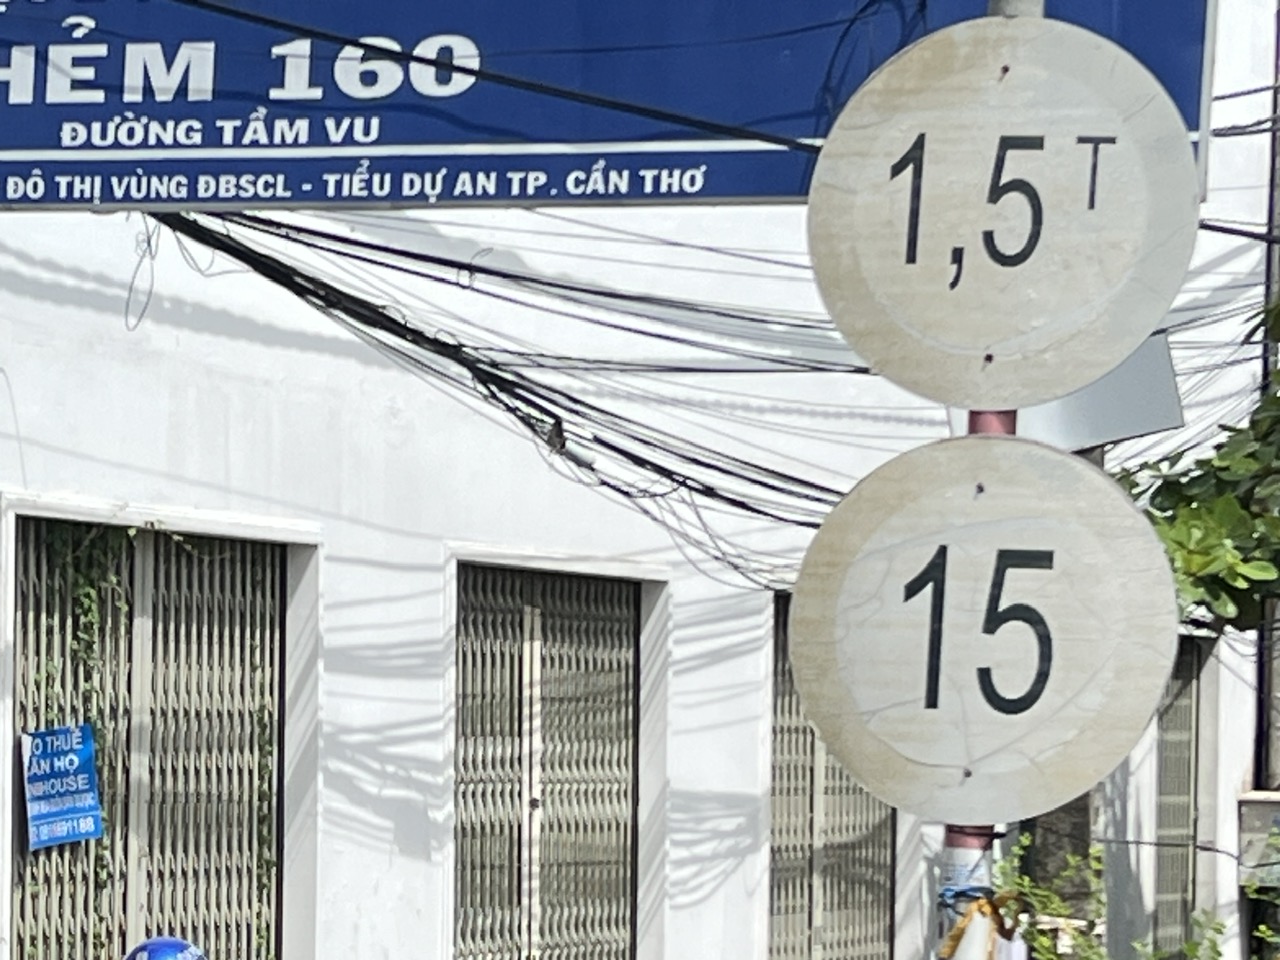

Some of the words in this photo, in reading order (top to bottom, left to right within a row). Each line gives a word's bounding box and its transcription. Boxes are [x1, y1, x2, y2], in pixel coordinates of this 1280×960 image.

[269, 34, 480, 100] 160
[61, 111, 202, 147] ĐƯỜNG
[324, 116, 380, 144] VU
[6, 168, 45, 200] ĐÔ
[54, 175, 101, 205] THỊ
[111, 168, 188, 200] VÙNG
[197, 173, 292, 199] ĐBSCL
[322, 158, 391, 197] TIỂU
[402, 167, 447, 204] DỰ
[639, 164, 707, 194] THƠ
[903, 544, 1054, 716] 15
